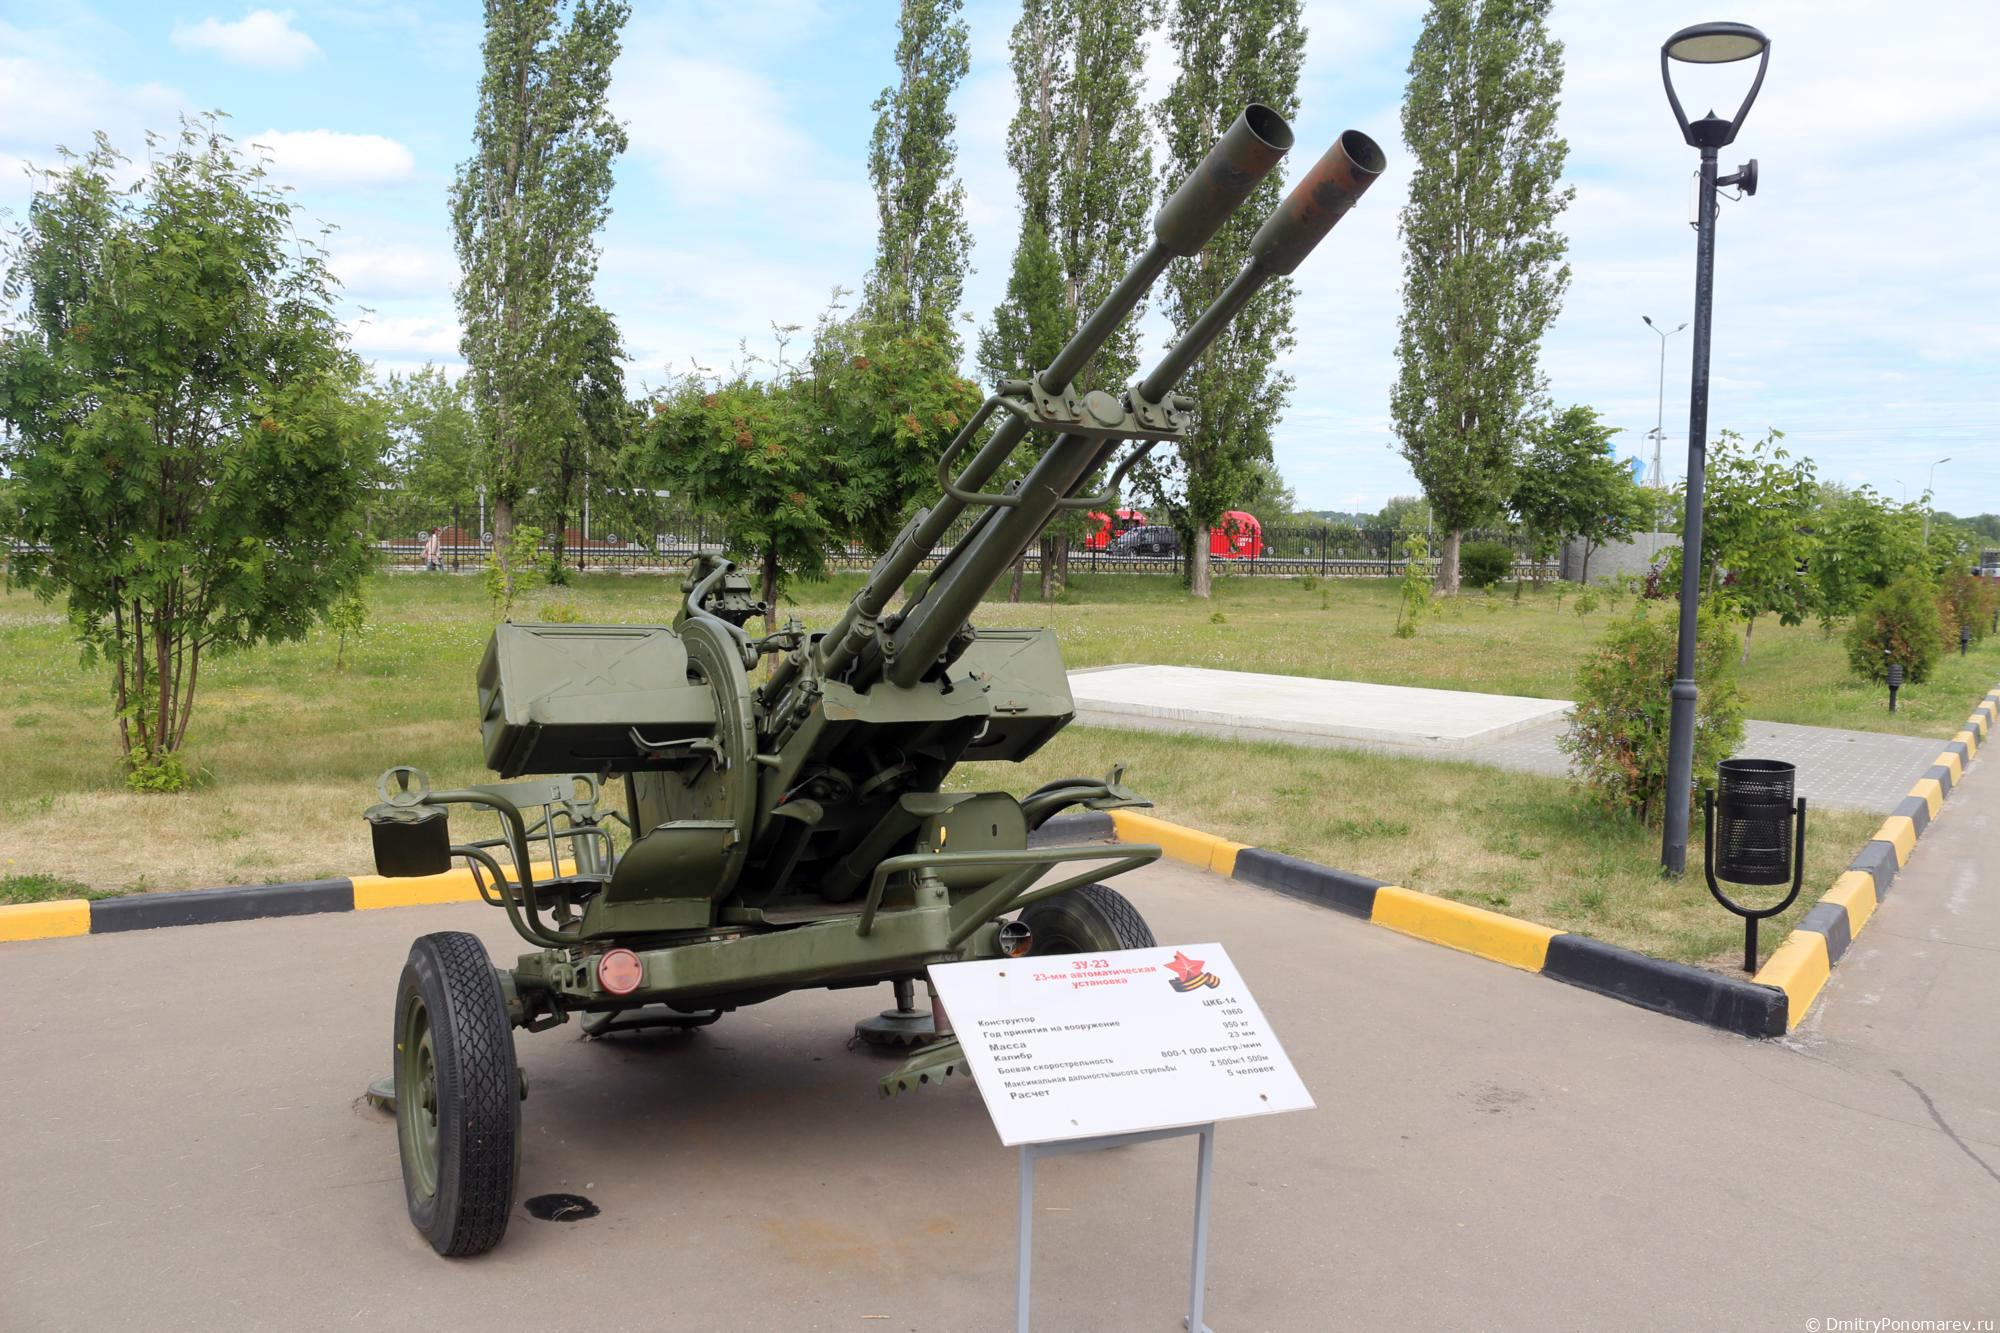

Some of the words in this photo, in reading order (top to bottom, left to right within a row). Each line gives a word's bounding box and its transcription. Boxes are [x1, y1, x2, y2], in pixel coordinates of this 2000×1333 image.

[1072, 959, 1109, 970] ЗУ-23
[1033, 973, 1067, 982] 23-мм
[1071, 966, 1157, 979] автоматическая
[1072, 977, 1128, 989] установка
[1202, 997, 1237, 1008] ЦКБ-14
[1221, 1008, 1243, 1016] 1960
[977, 1016, 1036, 1027] Конструктор
[1222, 1020, 1239, 1029] 950
[983, 1030, 1002, 1039] Год
[1004, 1026, 1048, 1038] принятия
[1050, 1025, 1062, 1033] на
[1064, 1020, 1120, 1032] вооружение
[988, 1042, 1027, 1052] Масса
[1161, 1049, 1187, 1058] 800-1
[1189, 1046, 1207, 1055] 000
[993, 1052, 1033, 1062] Калибр
[1247, 1054, 1269, 1063] 500м
[997, 1065, 1031, 1075] Боевая
[1033, 1057, 1114, 1072] скорострельность
[1227, 1069, 1234, 1077] 5
[1235, 1066, 1275, 1075] человек
[1004, 1076, 1067, 1089] Максимальная
[1068, 1069, 1139, 1083] дальность/высота
[1140, 1064, 1177, 1077] стрельбы
[1009, 1089, 1051, 1100] Расчет
